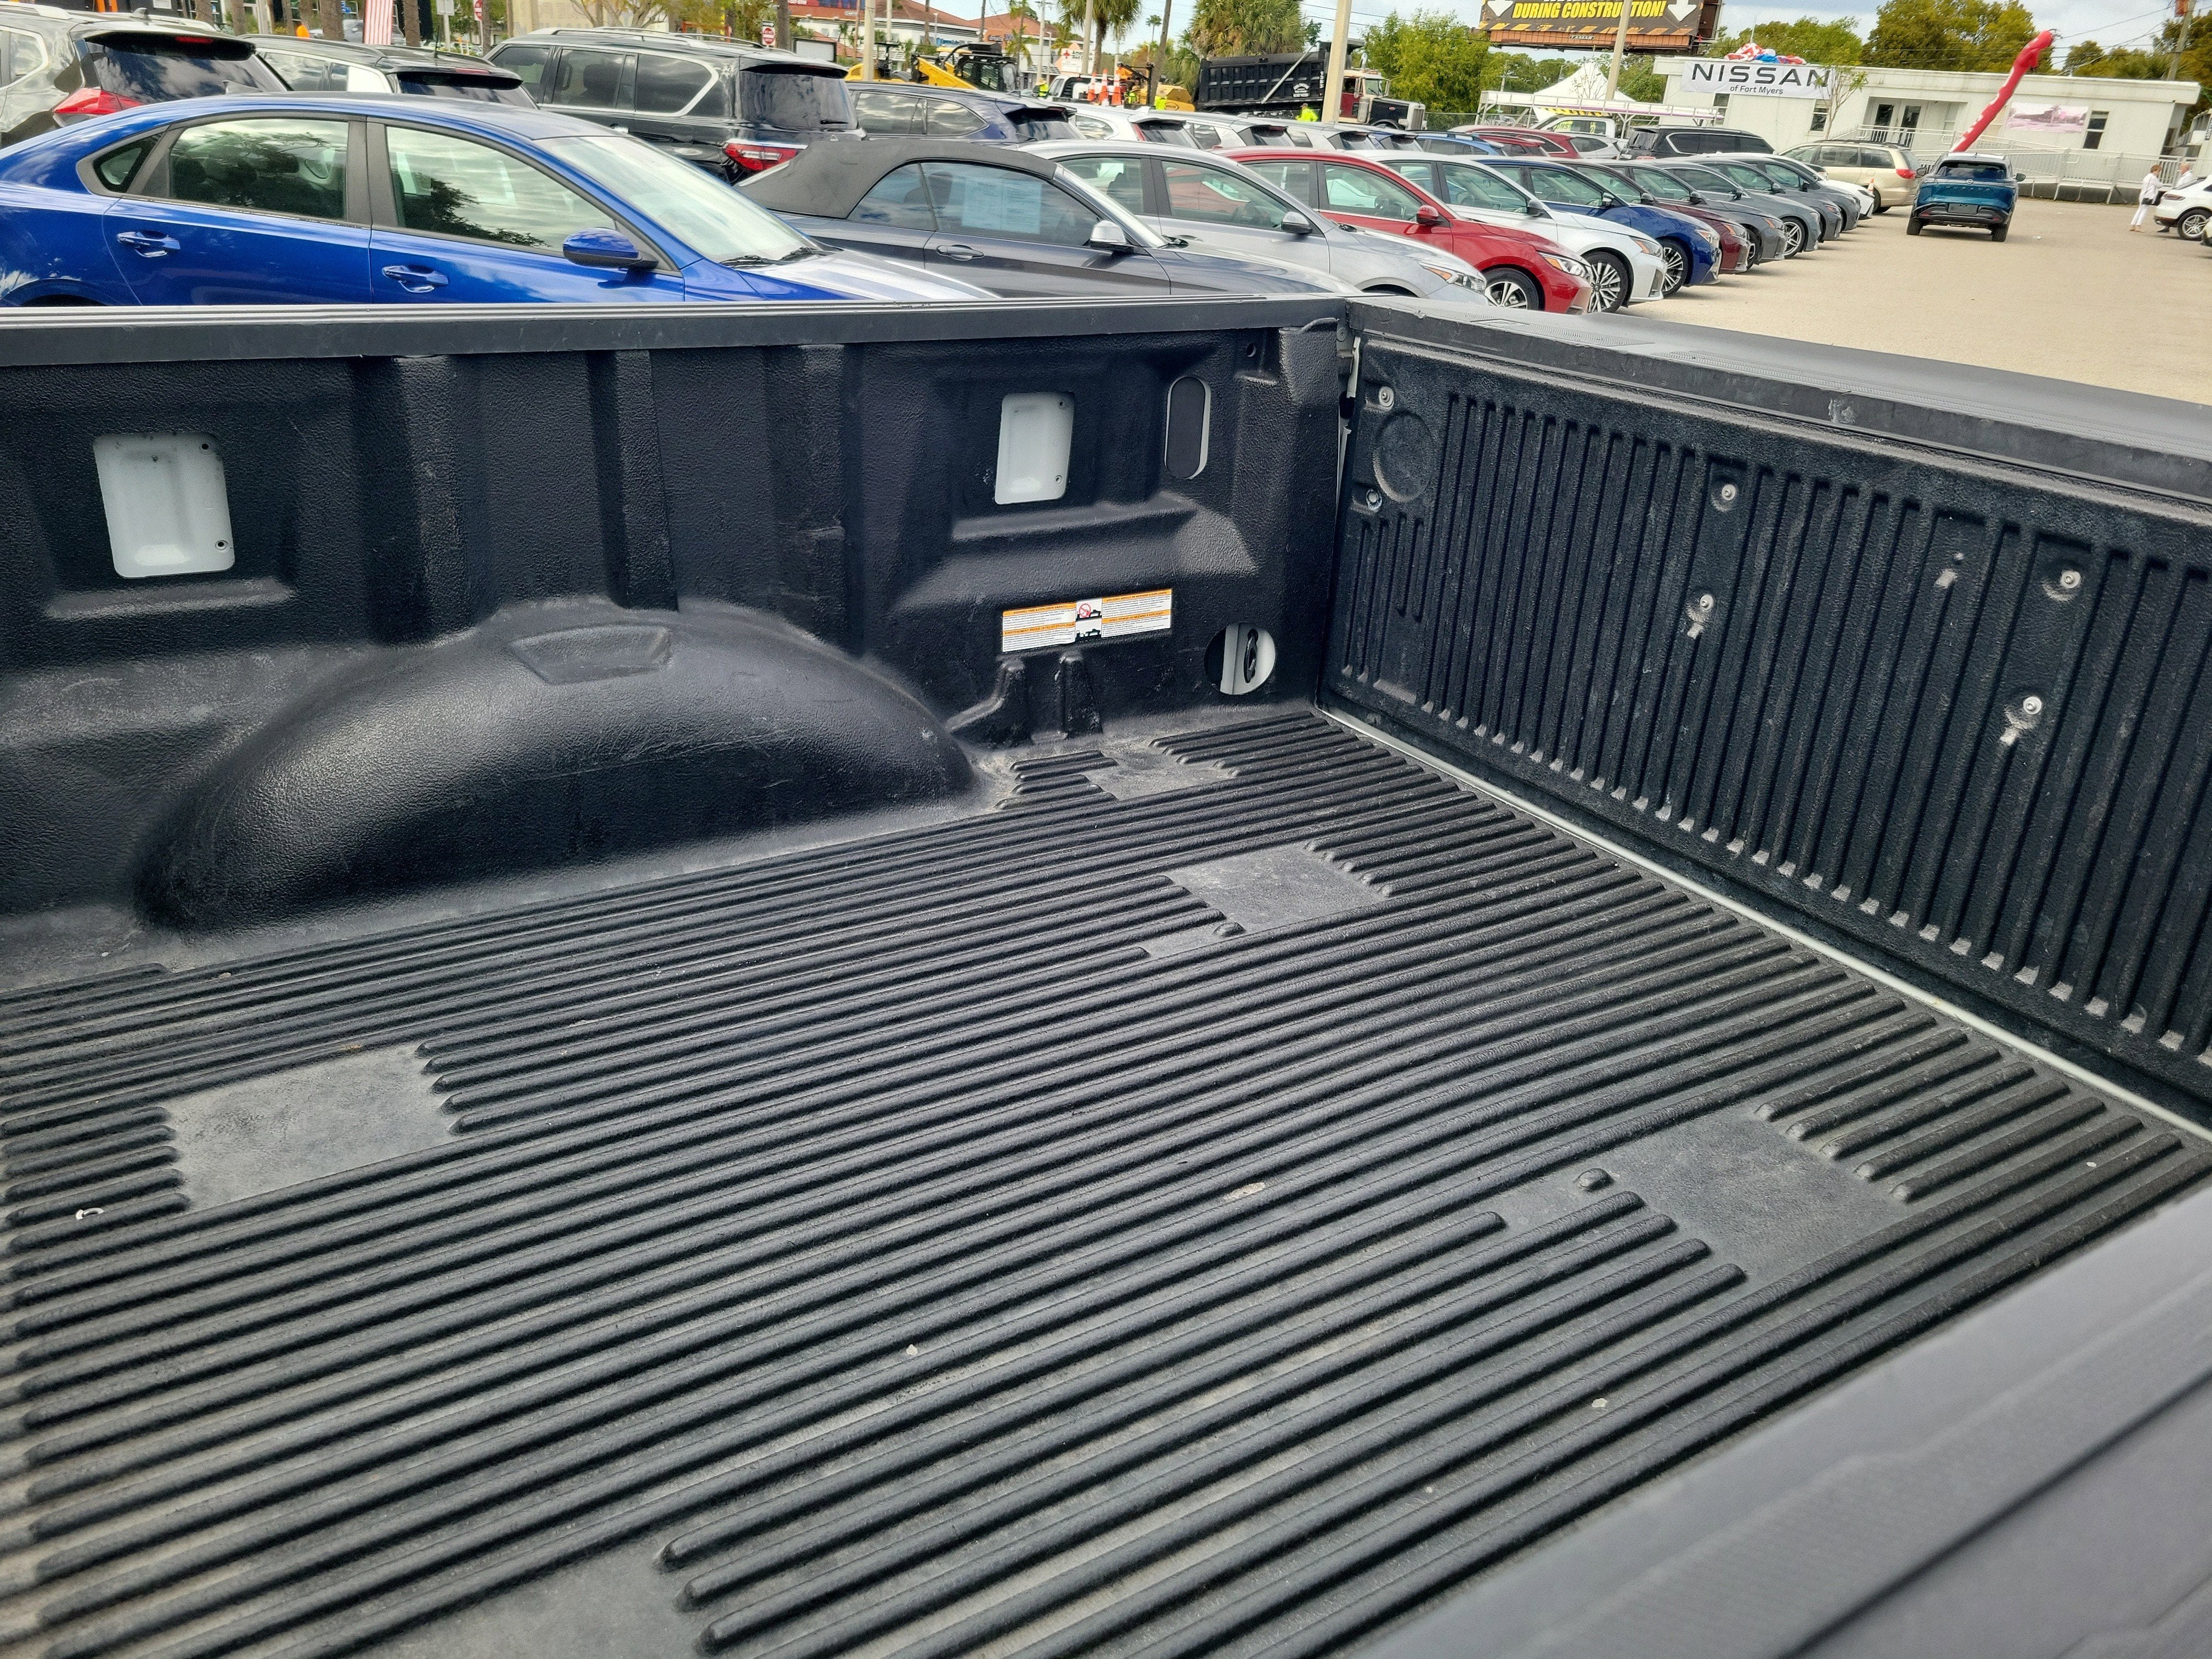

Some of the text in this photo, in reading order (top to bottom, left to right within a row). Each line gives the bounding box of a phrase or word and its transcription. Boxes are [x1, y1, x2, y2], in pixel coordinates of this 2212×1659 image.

[1512, 2, 1561, 19] DURING
[1691, 63, 1831, 87] NISSAN
[1759, 86, 1784, 95] Myers
